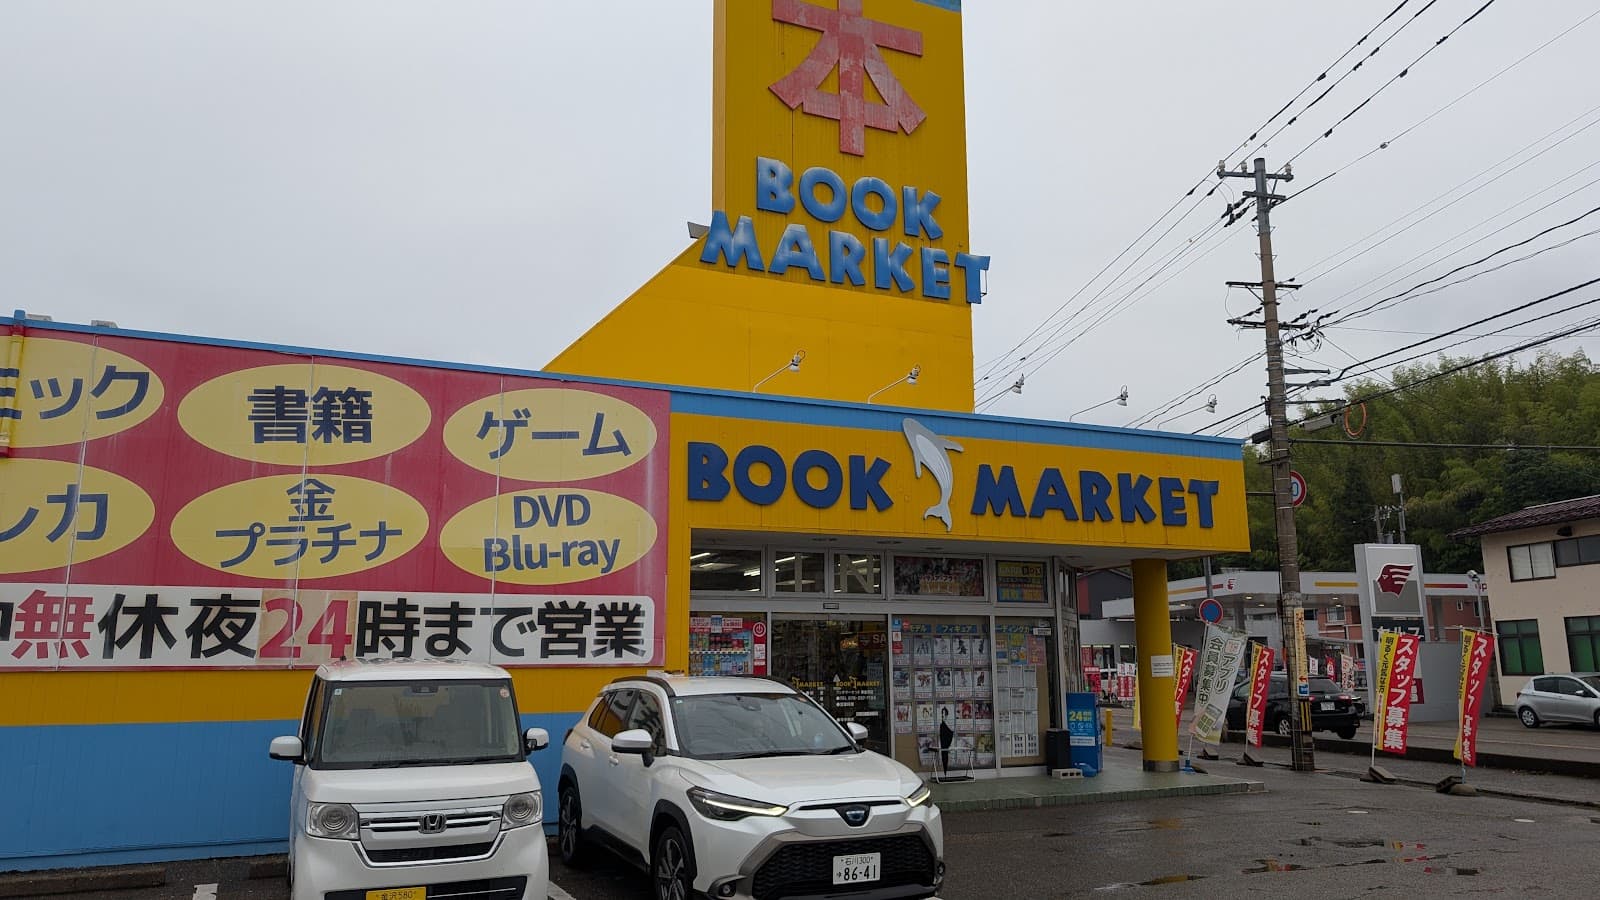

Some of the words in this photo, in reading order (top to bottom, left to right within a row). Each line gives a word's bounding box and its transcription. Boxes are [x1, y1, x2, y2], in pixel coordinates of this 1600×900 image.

[768, 0, 927, 156] 本
[756, 156, 943, 240] BOOK
[700, 210, 990, 304] MARKET
[247, 385, 374, 445] 書籍
[476, 407, 632, 460] ゲーム
[286, 478, 336, 521] 金
[513, 494, 591, 529] DVD
[687, 441, 894, 512] BOOK
[970, 463, 1220, 528] MARKET
[216, 520, 403, 568] プラチナ
[483, 535, 621, 574] Blu-ray
[0, 588, 647, 659] 無休夜24時まで営業
[1197, 636, 1224, 706] 会員募集中
[1214, 654, 1237, 695] アプリ
[1383, 637, 1414, 750] スタッフ募集
[843, 863, 876, 881] 86-41
